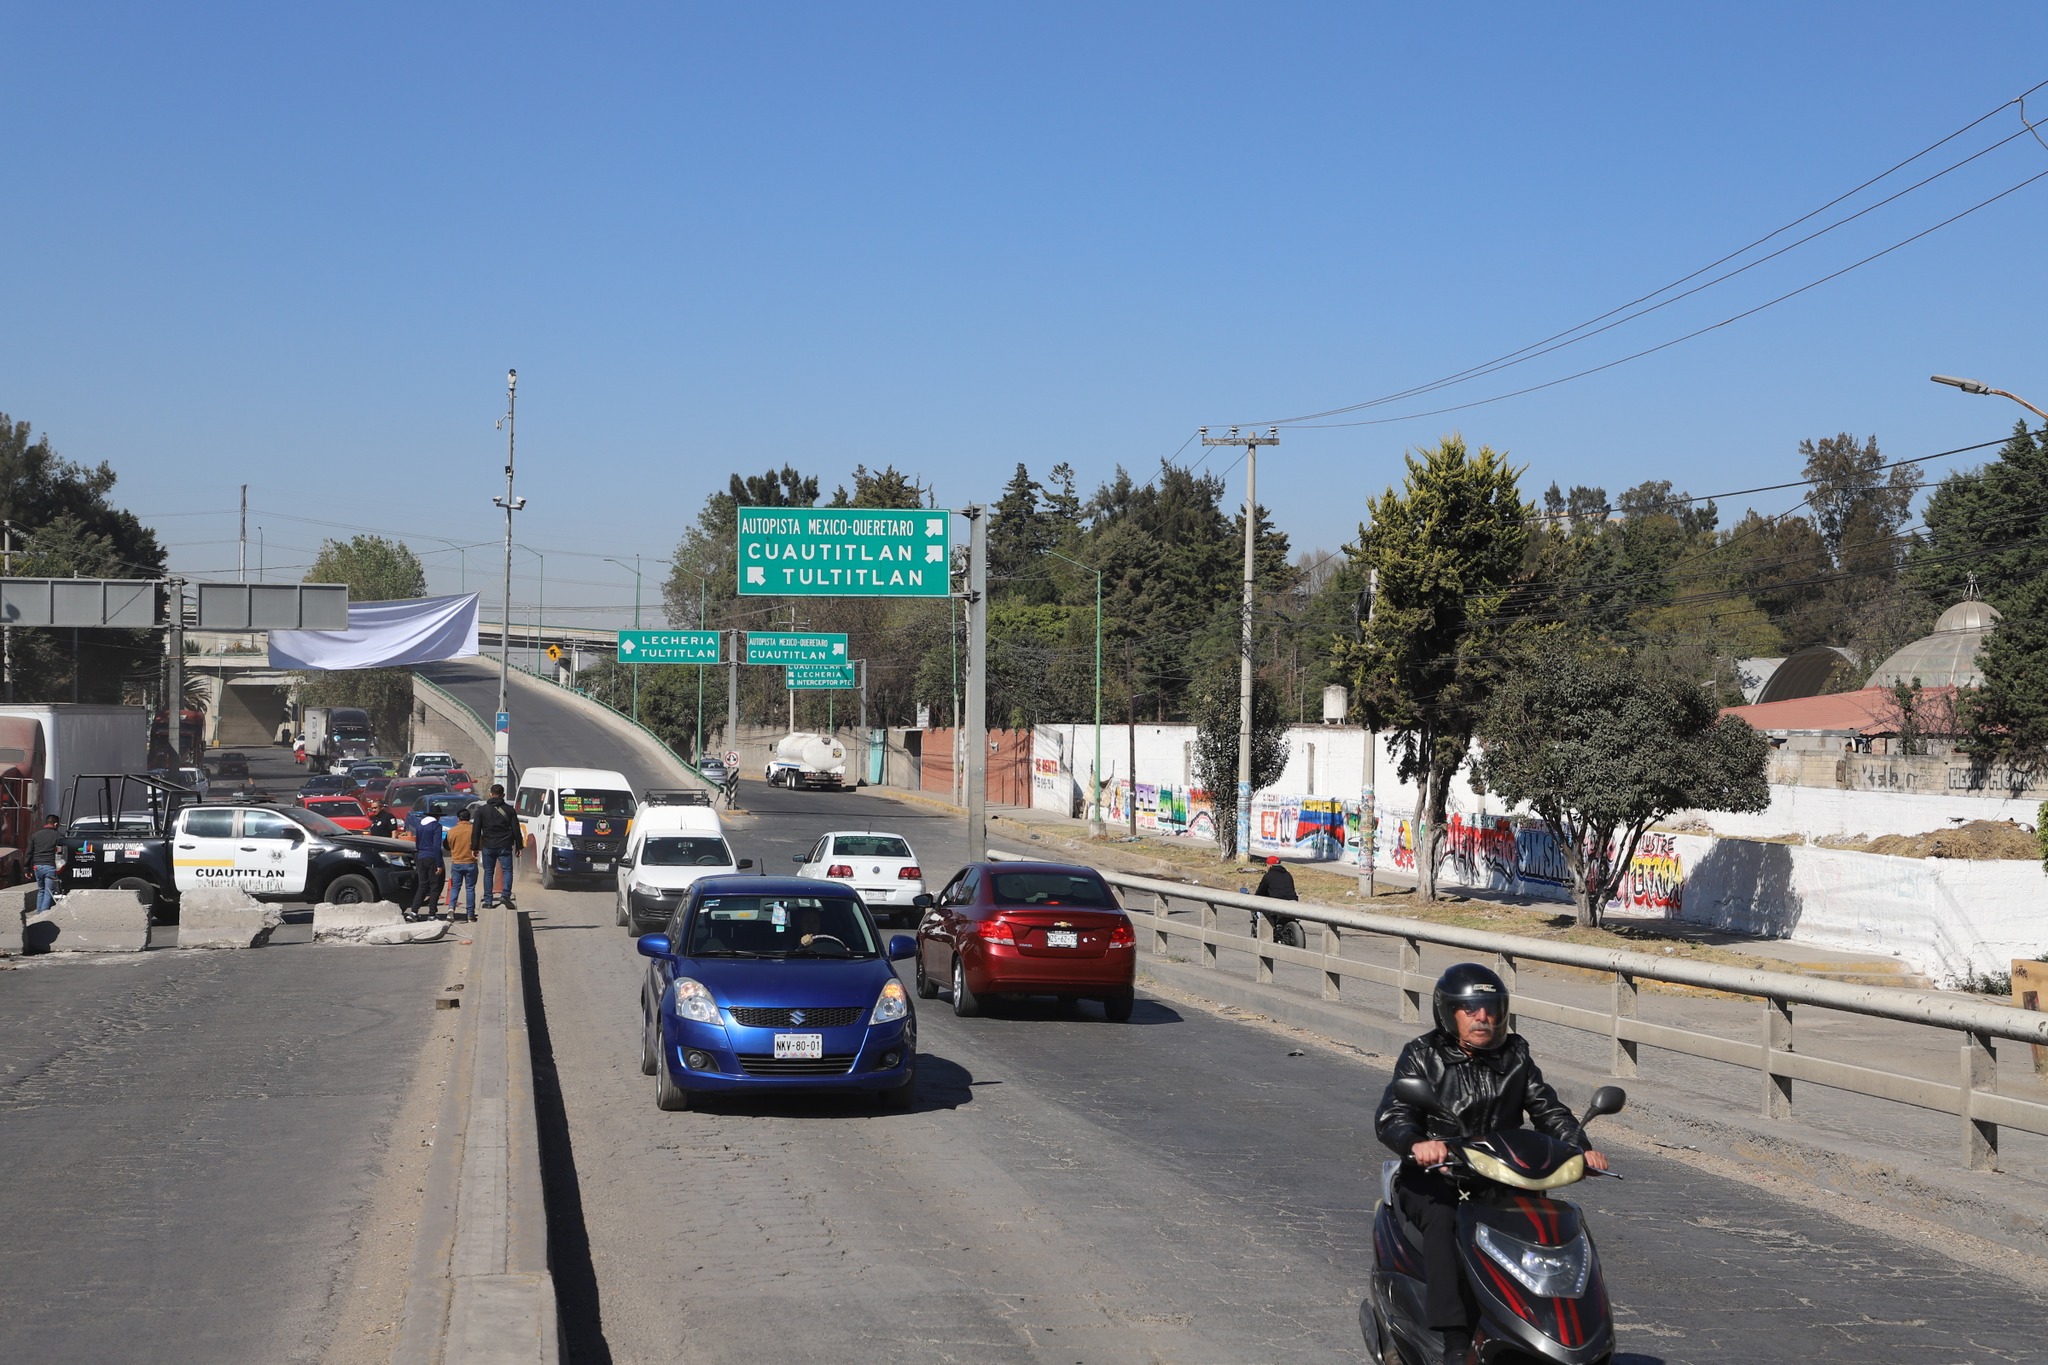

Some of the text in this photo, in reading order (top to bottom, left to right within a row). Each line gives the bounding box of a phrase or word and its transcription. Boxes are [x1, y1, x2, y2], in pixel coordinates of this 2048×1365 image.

[741, 518, 914, 536] AUTOPISTA MEXICO-QUERETARO
[747, 543, 912, 561] CUAUTITLAN
[783, 568, 923, 586] TULTITLAN
[642, 636, 715, 645] LECHERIA
[749, 638, 828, 647] AUTOPISTA MEXICO-QUERETARO
[641, 649, 715, 658] TULTITLAN
[750, 650, 826, 660] CUAUTITLAN
[195, 869, 285, 878] CUAUTITLAN
[776, 1041, 820, 1051] NKV-80-01
